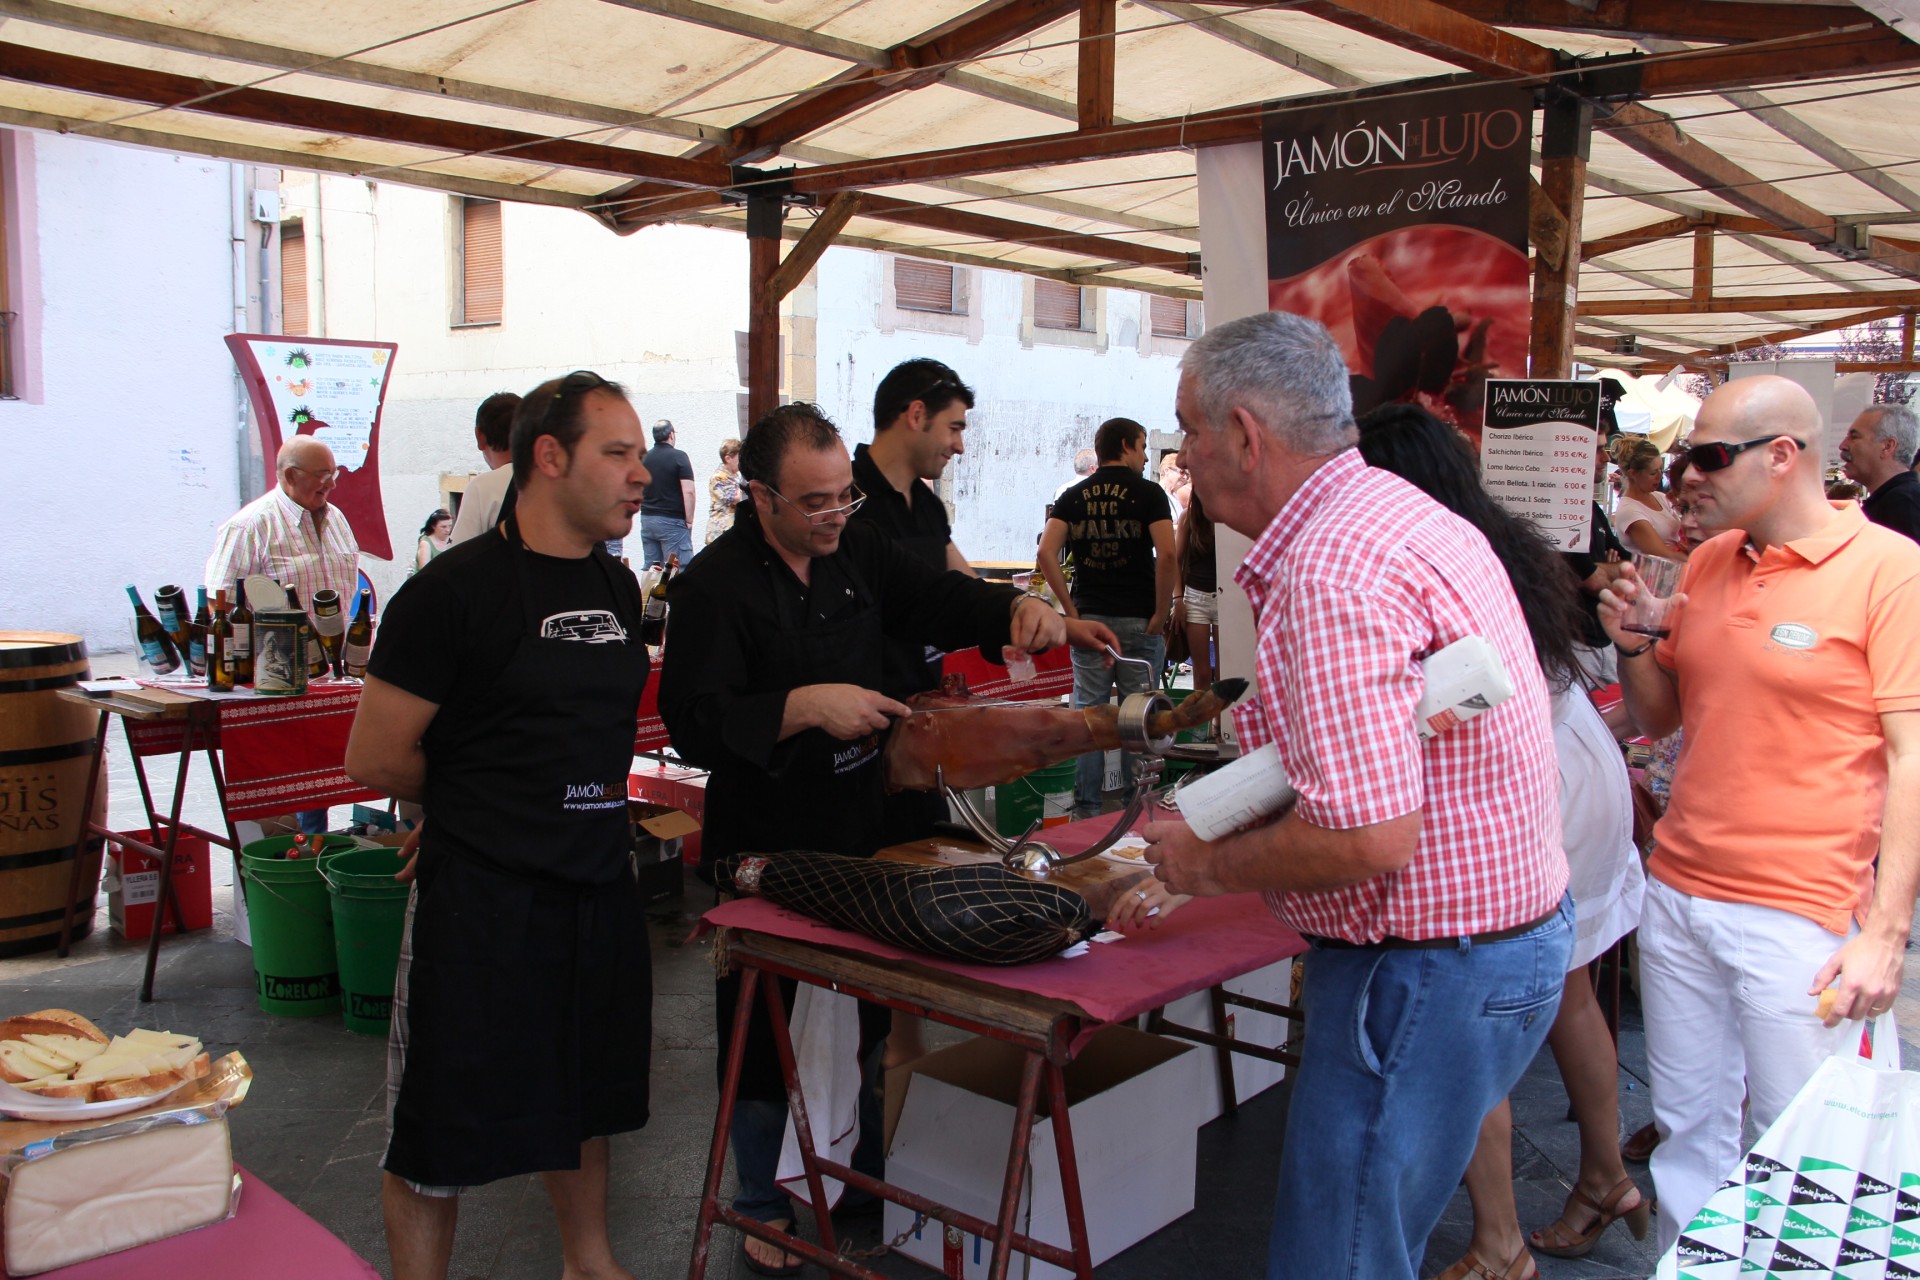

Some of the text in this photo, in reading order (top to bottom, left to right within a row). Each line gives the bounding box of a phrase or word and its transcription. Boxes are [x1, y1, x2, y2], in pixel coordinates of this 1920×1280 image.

[1273, 120, 1408, 190] JAMÓN
[1420, 109, 1522, 165] LUJO
[1284, 178, 1508, 227] Único en el Mundo
[1493, 385, 1593, 407] JAMÓN LUJO
[1496, 404, 1522, 418] Único
[1548, 408, 1586, 419] Mundo
[1082, 483, 1128, 500] ROYAL
[1087, 501, 1118, 515] NYC
[563, 781, 604, 800] JAMÓN
[637, 787, 668, 801] YLLERA
[684, 797, 703, 809] YLLE
[140, 854, 193, 869] YLRA
[266, 977, 329, 998] ZORELOR
